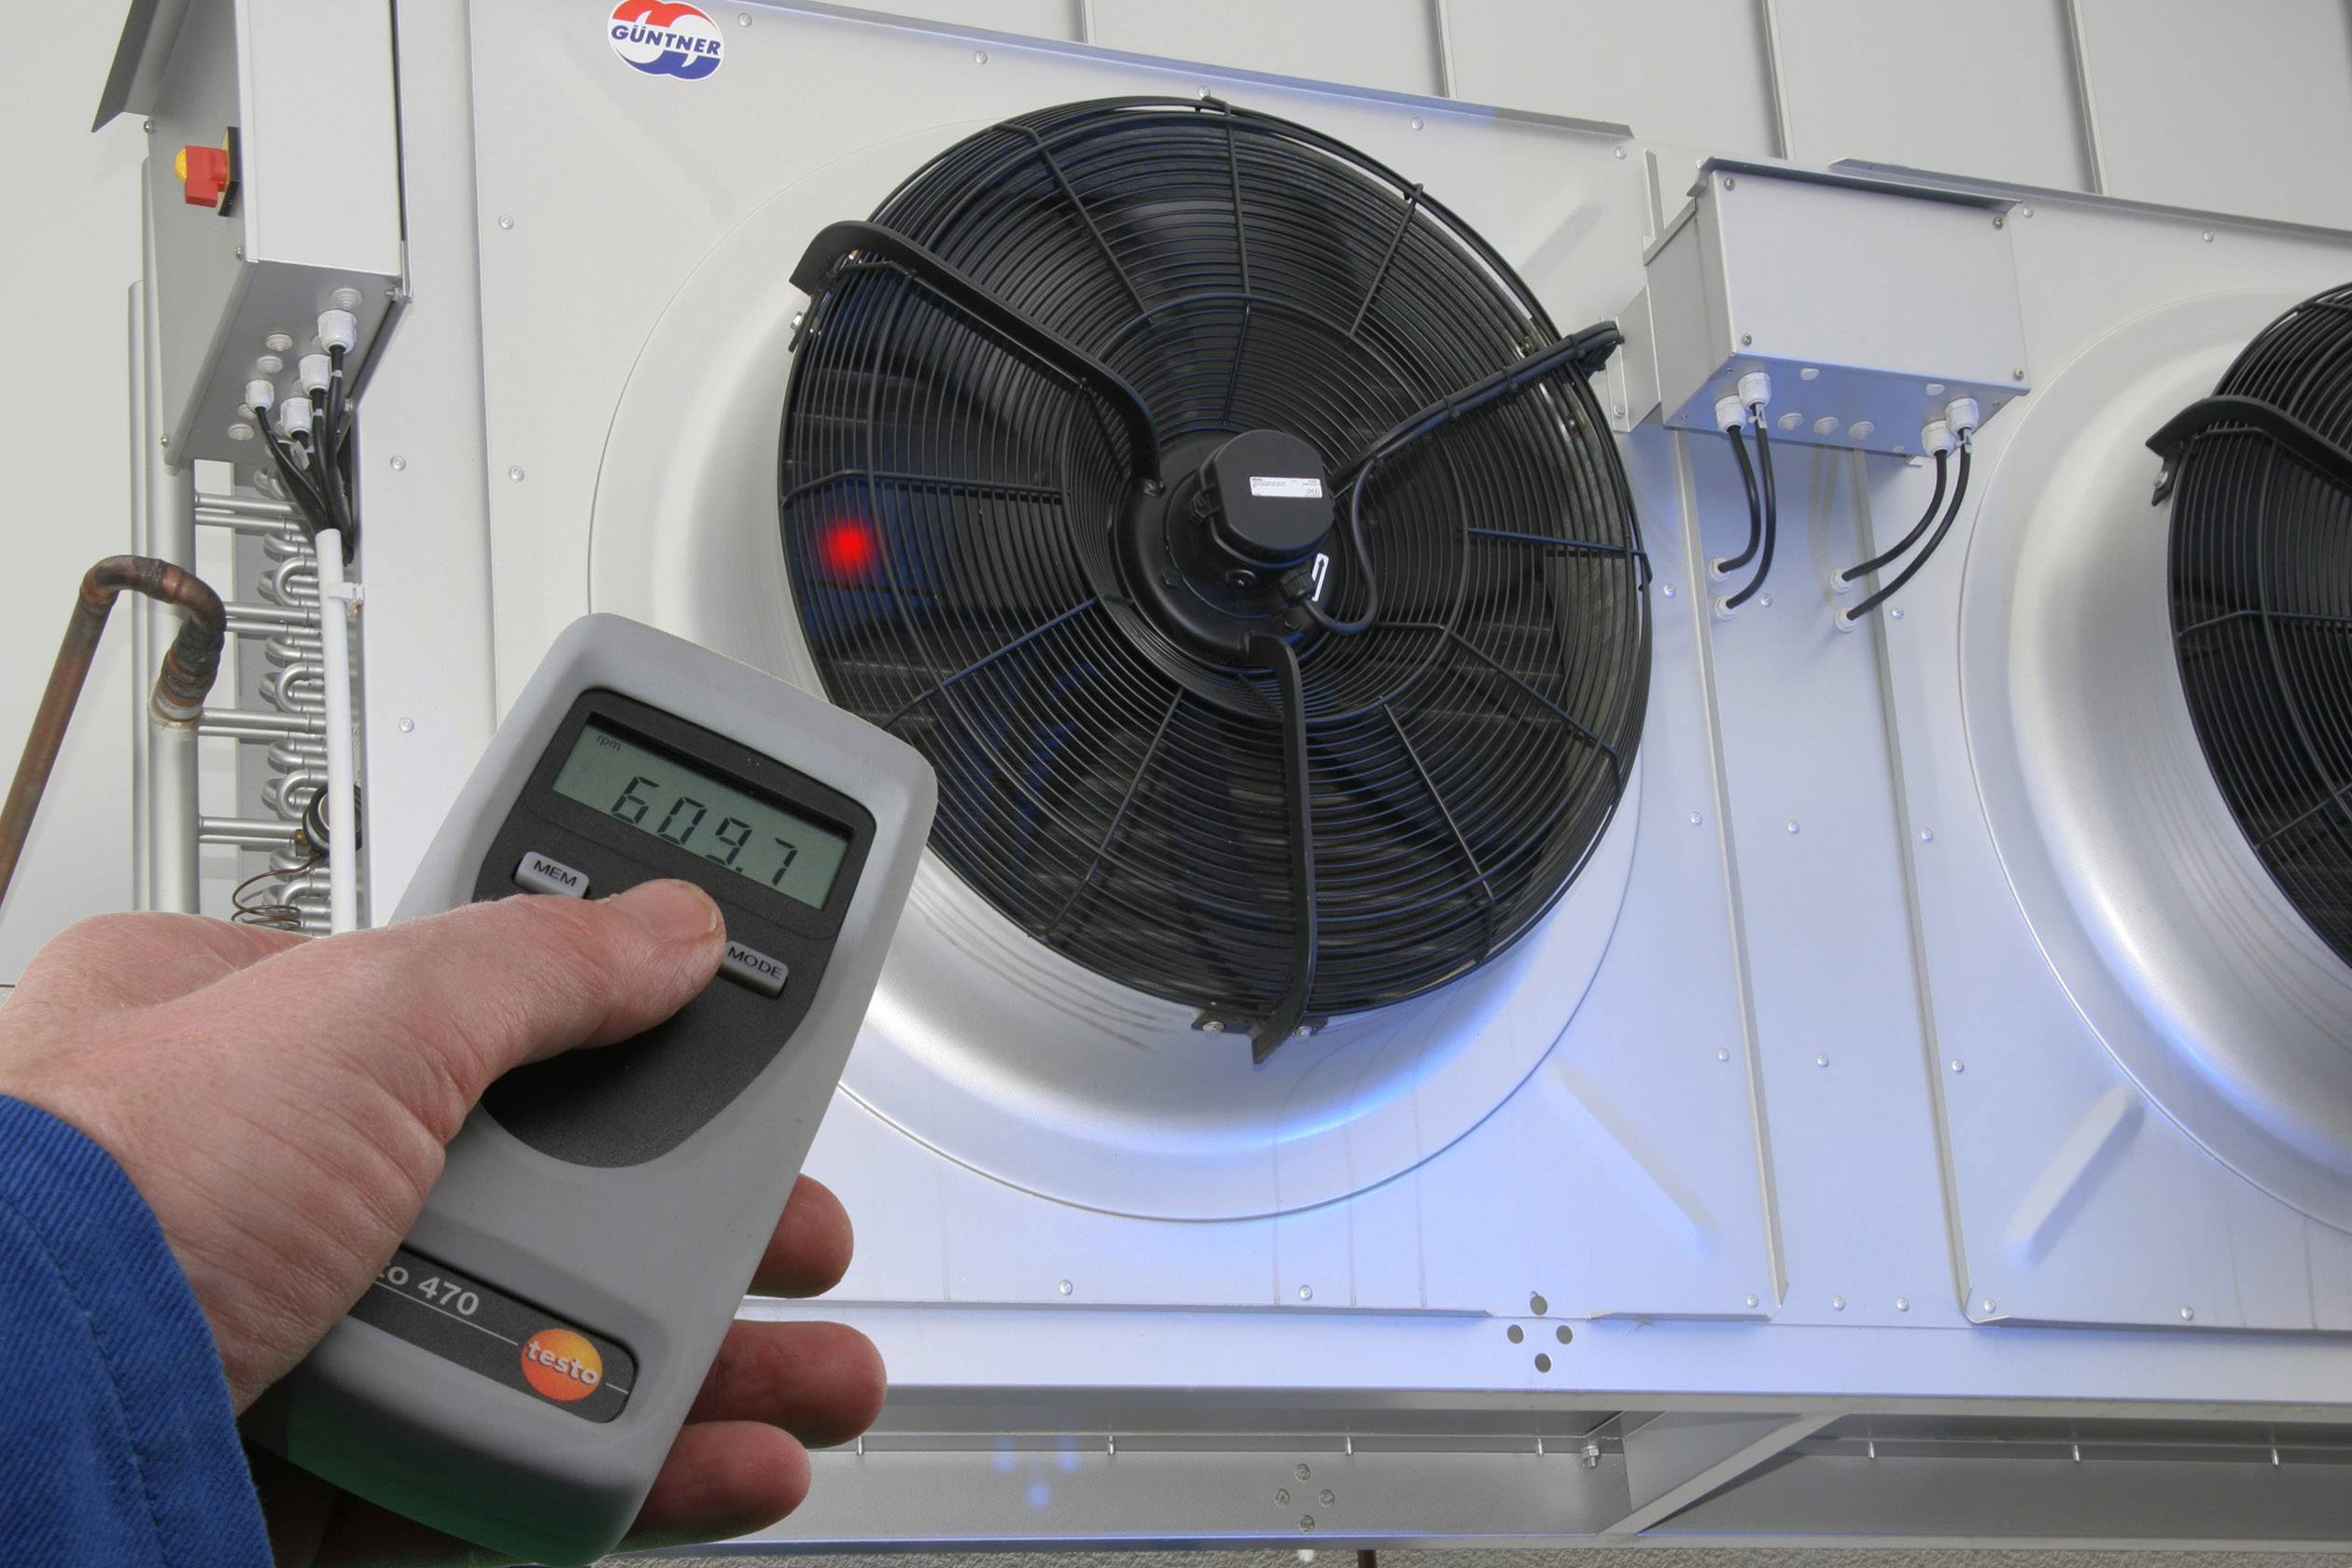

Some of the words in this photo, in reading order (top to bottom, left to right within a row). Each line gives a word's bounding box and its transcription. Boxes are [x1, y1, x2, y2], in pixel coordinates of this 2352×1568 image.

[611, 24, 721, 56] GÜNTNER
[596, 735, 622, 752] rpm
[610, 776, 798, 887] 609.7
[533, 859, 578, 888] MEM
[727, 945, 784, 980] MODE
[417, 1276, 480, 1316] 470
[525, 1339, 599, 1386] testo
